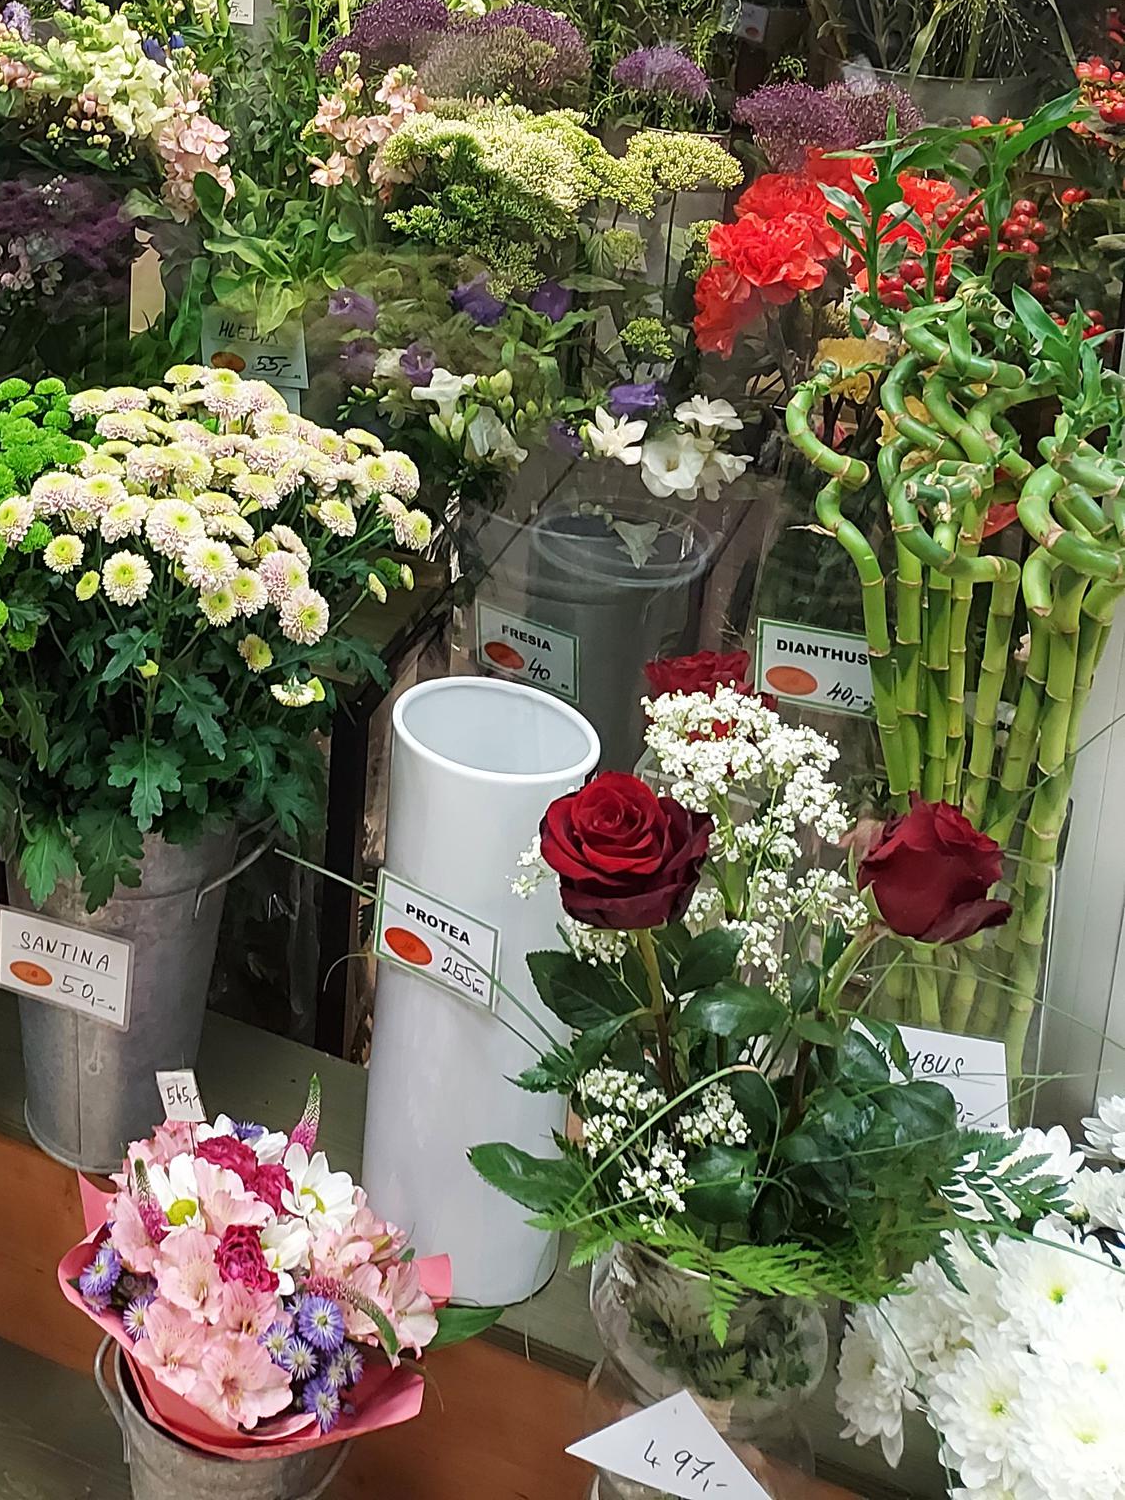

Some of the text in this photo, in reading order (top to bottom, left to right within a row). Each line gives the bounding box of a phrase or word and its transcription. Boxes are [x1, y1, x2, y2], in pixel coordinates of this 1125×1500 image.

[501, 624, 552, 652] FRESIA
[776, 639, 869, 665] DIANTHUS
[527, 657, 551, 680] 40
[405, 902, 471, 946] PROTEA
[19, 930, 111, 971] SANTINA
